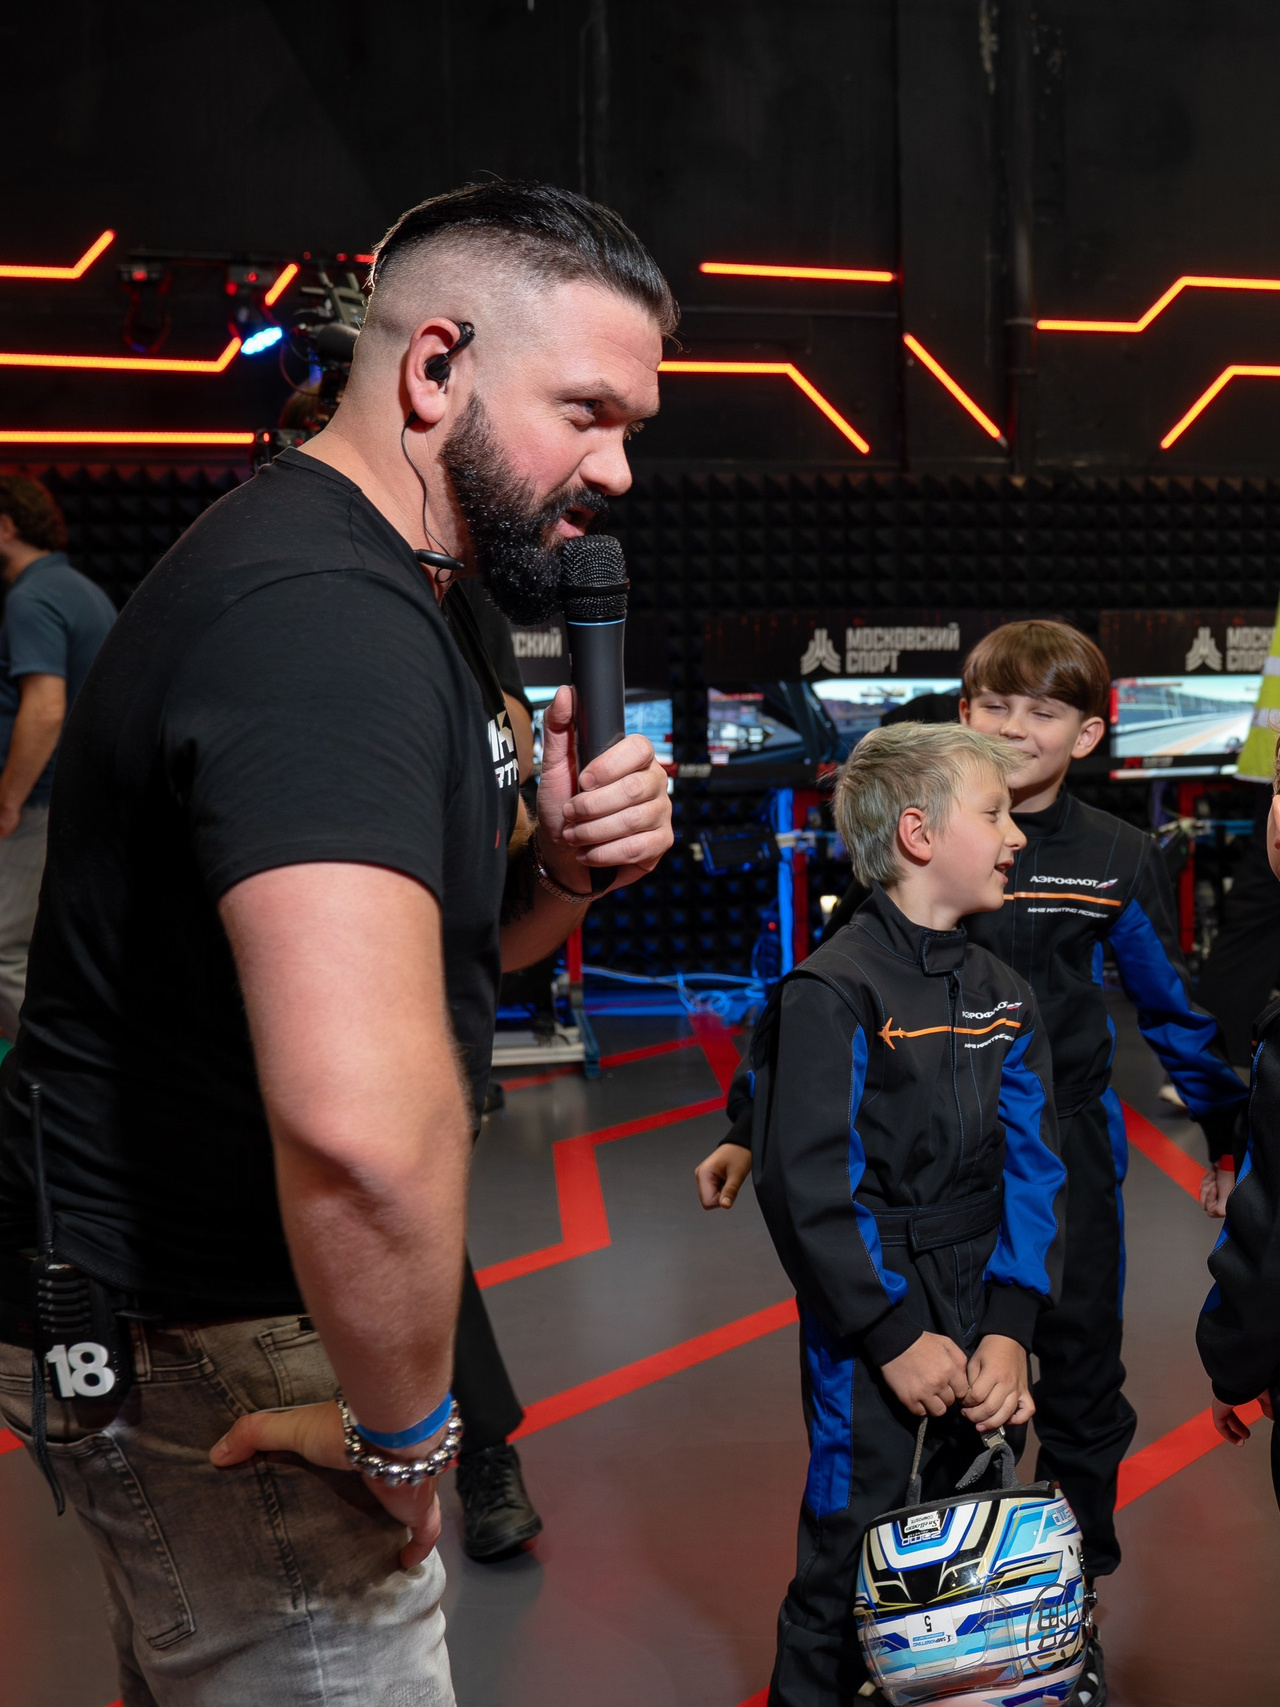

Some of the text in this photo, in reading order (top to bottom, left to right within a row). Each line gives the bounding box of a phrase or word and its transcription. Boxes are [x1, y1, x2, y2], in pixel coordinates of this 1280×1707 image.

[512, 626, 563, 658] СКИЙ
[845, 622, 960, 651] МОСКОВСКИЙ
[1226, 626, 1277, 649] МОСК
[845, 650, 900, 673] СПОРТ
[1030, 875, 1099, 888] АЭРОФЛОТ
[45, 1342, 116, 1398] 18
[924, 1615, 932, 1633] 5
